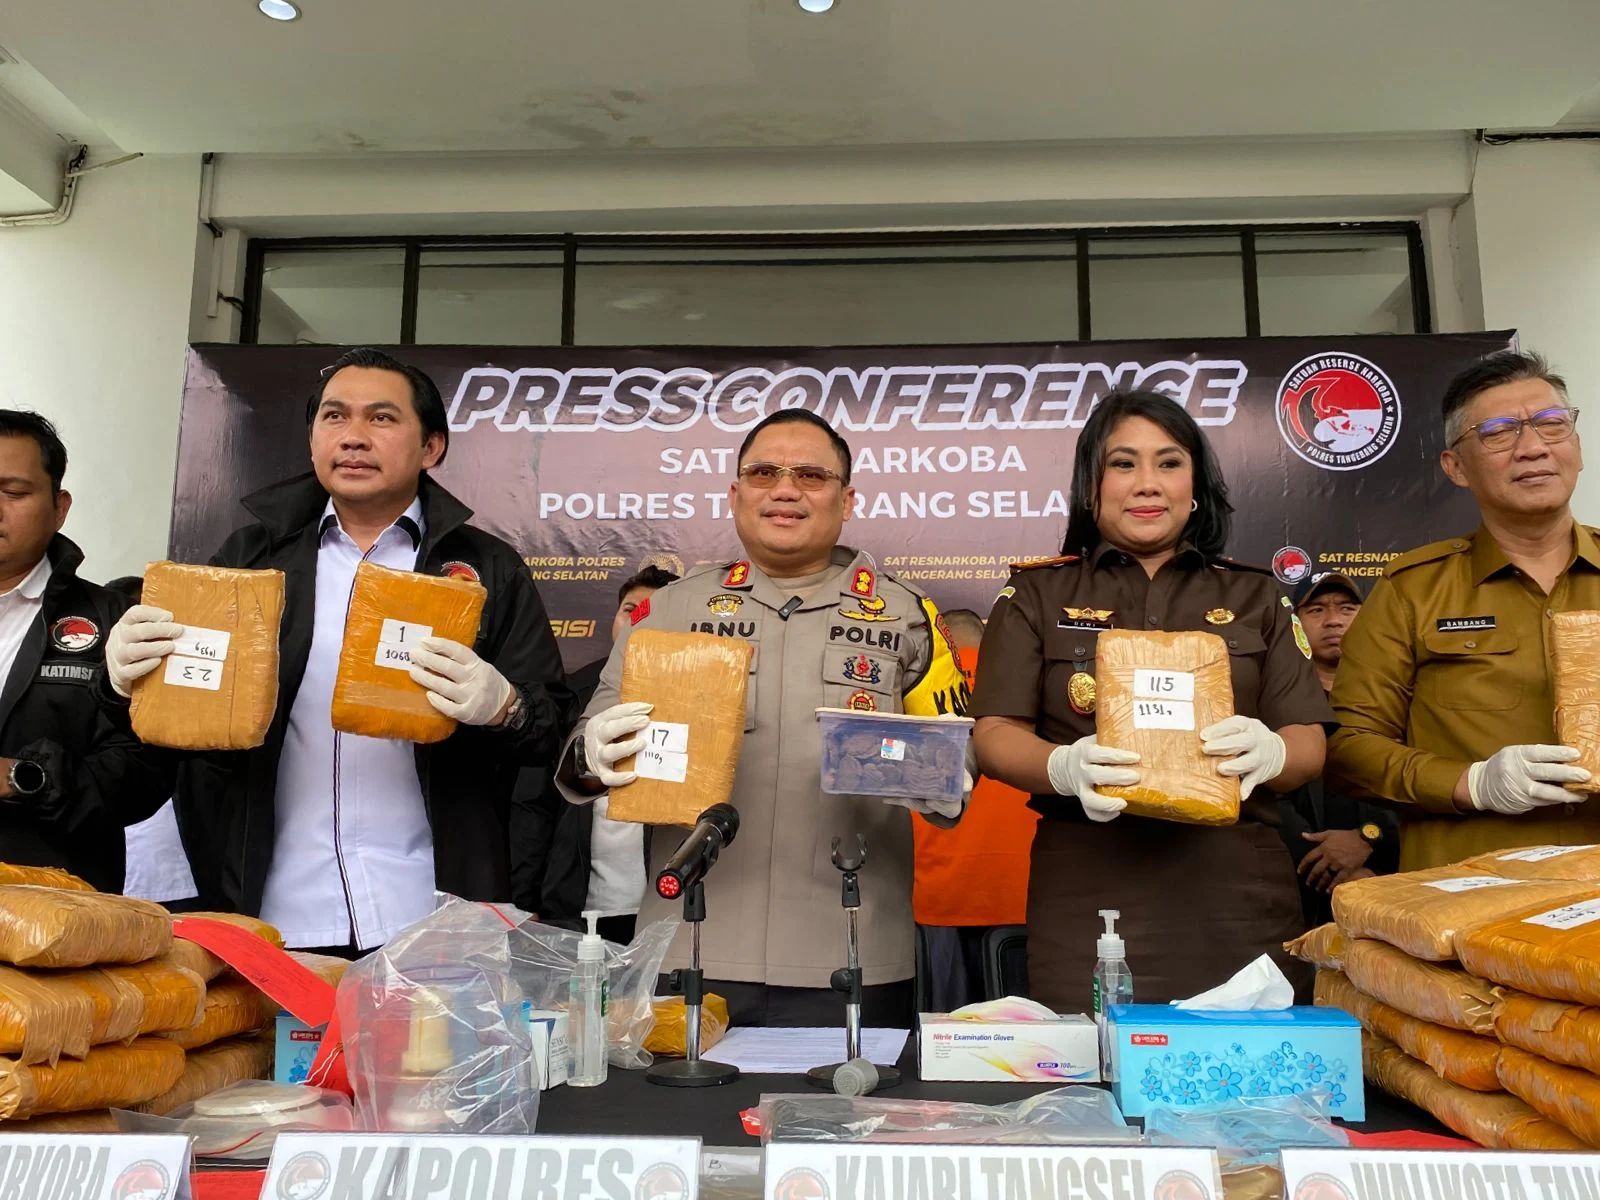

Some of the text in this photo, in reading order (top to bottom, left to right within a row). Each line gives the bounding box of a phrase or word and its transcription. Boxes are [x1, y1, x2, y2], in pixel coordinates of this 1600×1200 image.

[1288, 358, 1392, 405] SATUAN RESERSE NARKOBA
[449, 367, 714, 432] PRESS
[1306, 416, 1395, 465] POLRES TANGERANG SELATAN
[659, 447, 734, 474] SAT
[539, 492, 695, 520] POLRES
[704, 493, 734, 519] T
[577, 556, 626, 567] POLRES
[883, 555, 1049, 566] SAT RESNARKOBA POLR
[1319, 552, 1344, 563] SAT
[552, 570, 608, 581] SELATAN
[896, 570, 973, 580] TANGERANG
[1446, 619, 1486, 627] BAMBANG
[829, 625, 900, 651] POLRI
[1150, 676, 1174, 693] 115
[651, 728, 670, 747] 17
[933, 1033, 1014, 1041] Nitrile Examination Gloves
[328, 1145, 635, 1200] KAPOLRES
